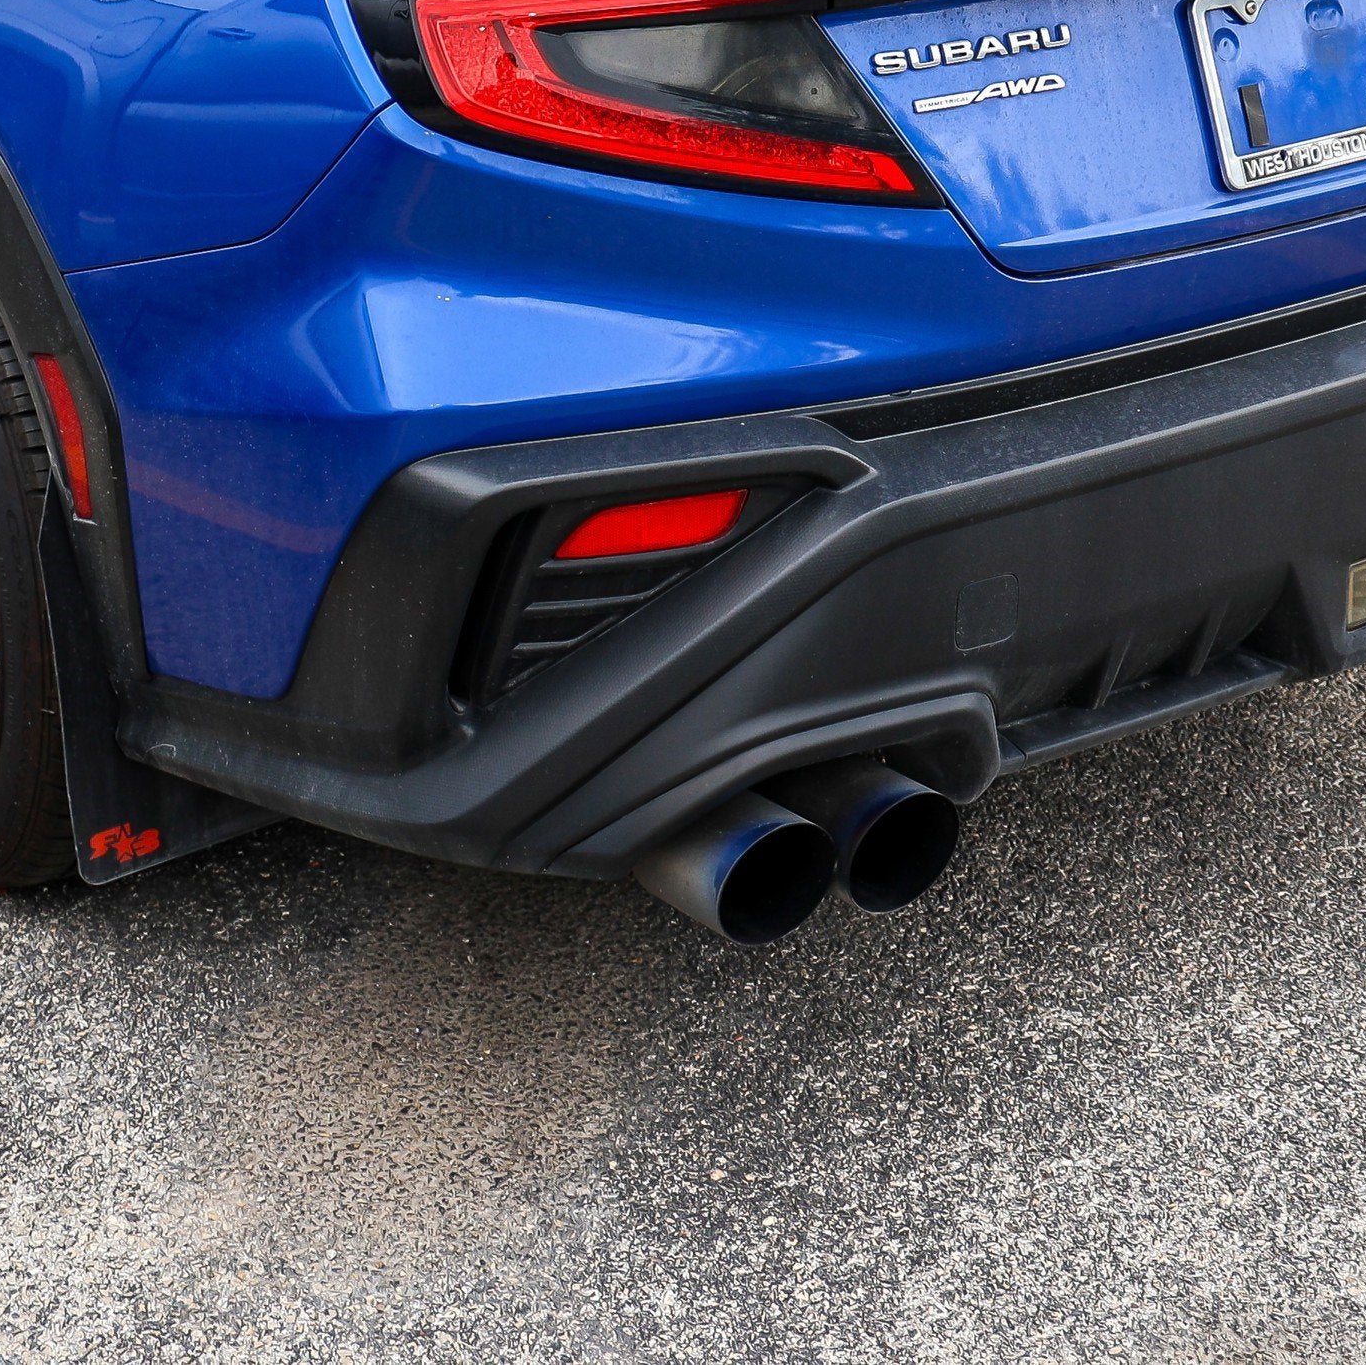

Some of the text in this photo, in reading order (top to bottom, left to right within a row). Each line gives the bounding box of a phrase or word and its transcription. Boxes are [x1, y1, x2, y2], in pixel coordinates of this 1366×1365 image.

[871, 23, 1072, 75] SUBARU
[919, 73, 1067, 110] SYMMETRICAL AWD
[1244, 148, 1293, 179] WEST
